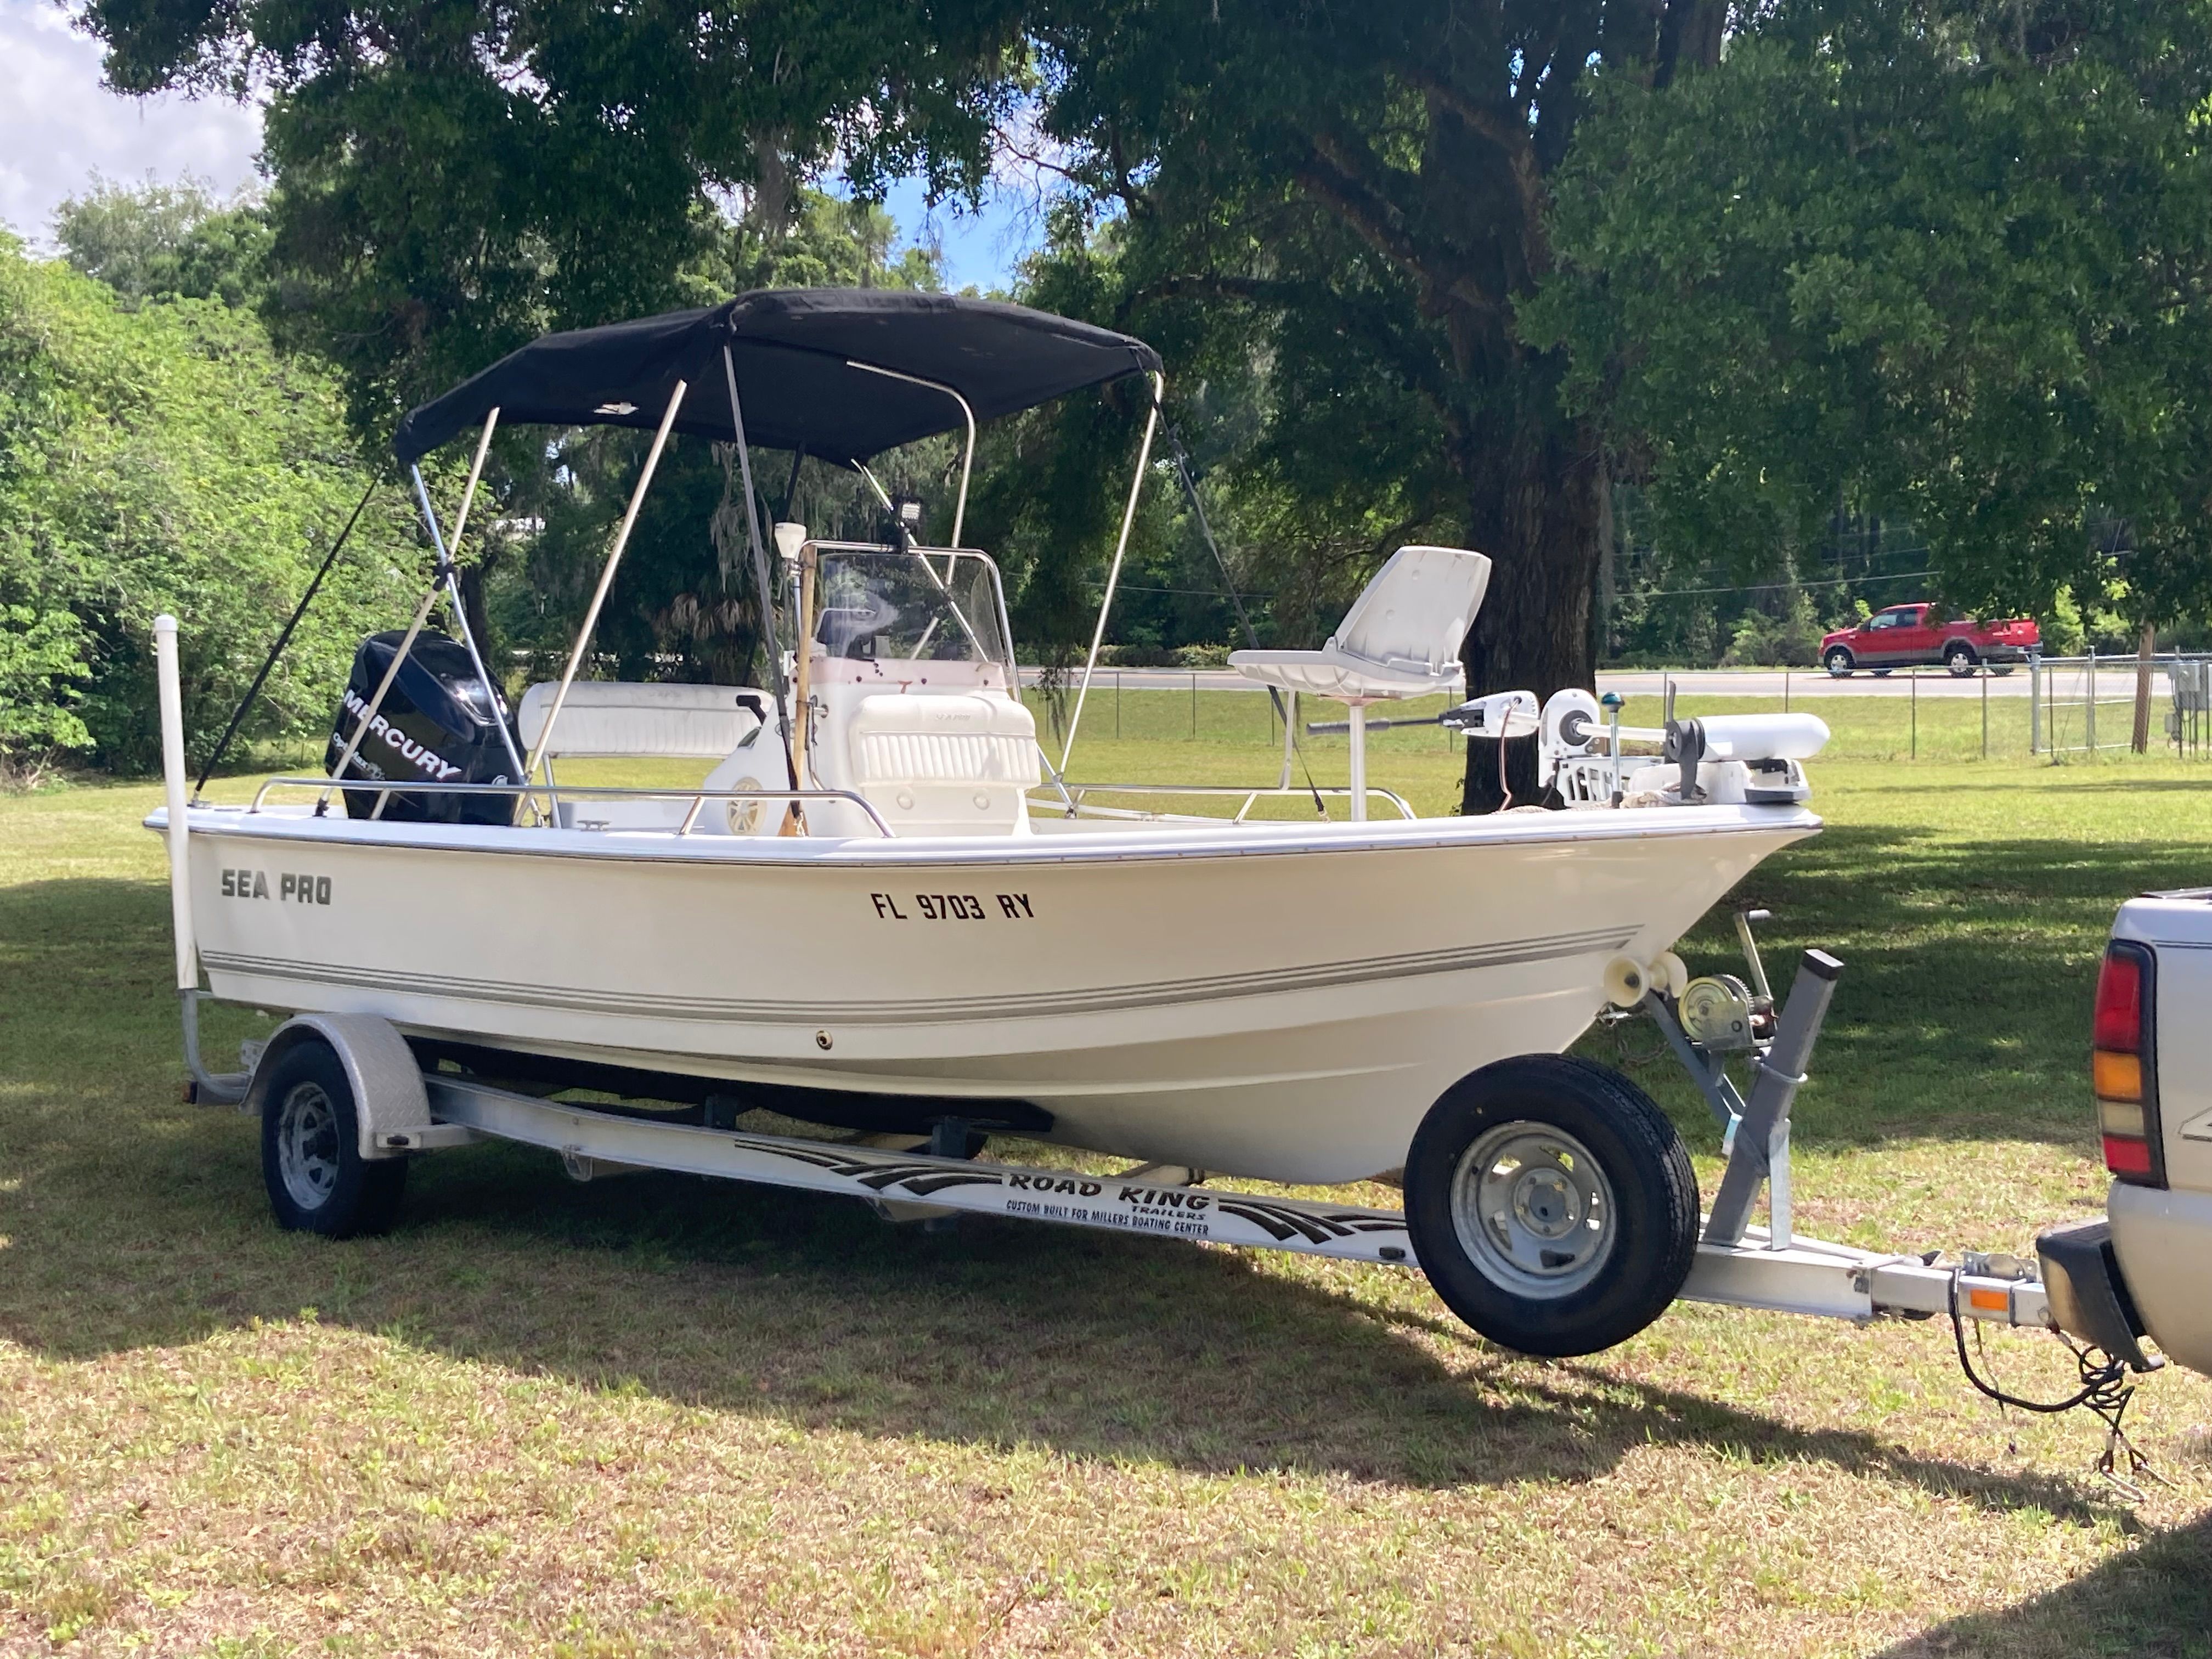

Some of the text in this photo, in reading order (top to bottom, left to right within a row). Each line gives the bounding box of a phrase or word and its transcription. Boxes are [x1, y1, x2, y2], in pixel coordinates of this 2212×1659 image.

[222, 869, 331, 905] SEA PRO
[870, 893, 1035, 919] FL 9703 RY
[1009, 1173, 1210, 1210] ROAD KING
[1006, 1199, 1209, 1235] CUSTOM BUILT FOR MILLERS BOATING CENTER
[1131, 1205, 1206, 1221] TRAILERS
